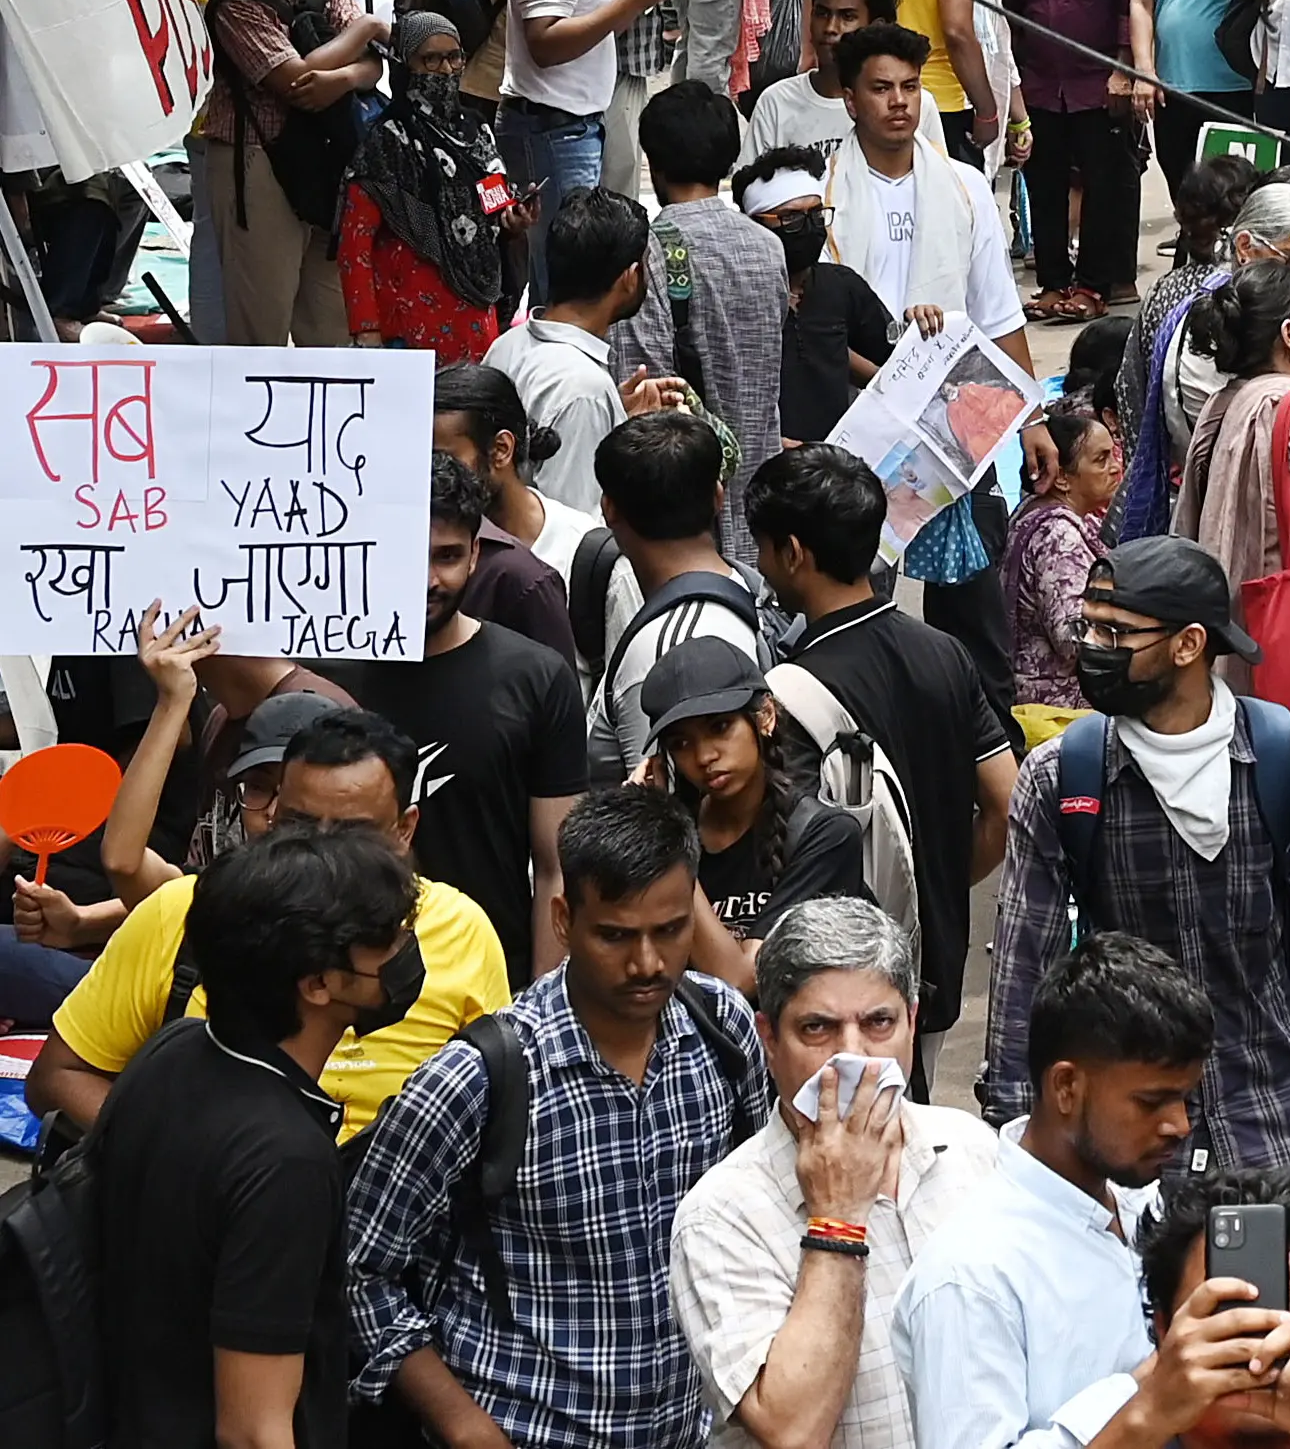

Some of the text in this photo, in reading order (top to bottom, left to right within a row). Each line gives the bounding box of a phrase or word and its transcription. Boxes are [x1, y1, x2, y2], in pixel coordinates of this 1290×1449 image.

[26, 360, 375, 495] सब याद
[75, 478, 348, 538] SAB YAAD
[20, 541, 377, 623] रखा जाएगा
[280, 610, 407, 658] JAEGA
